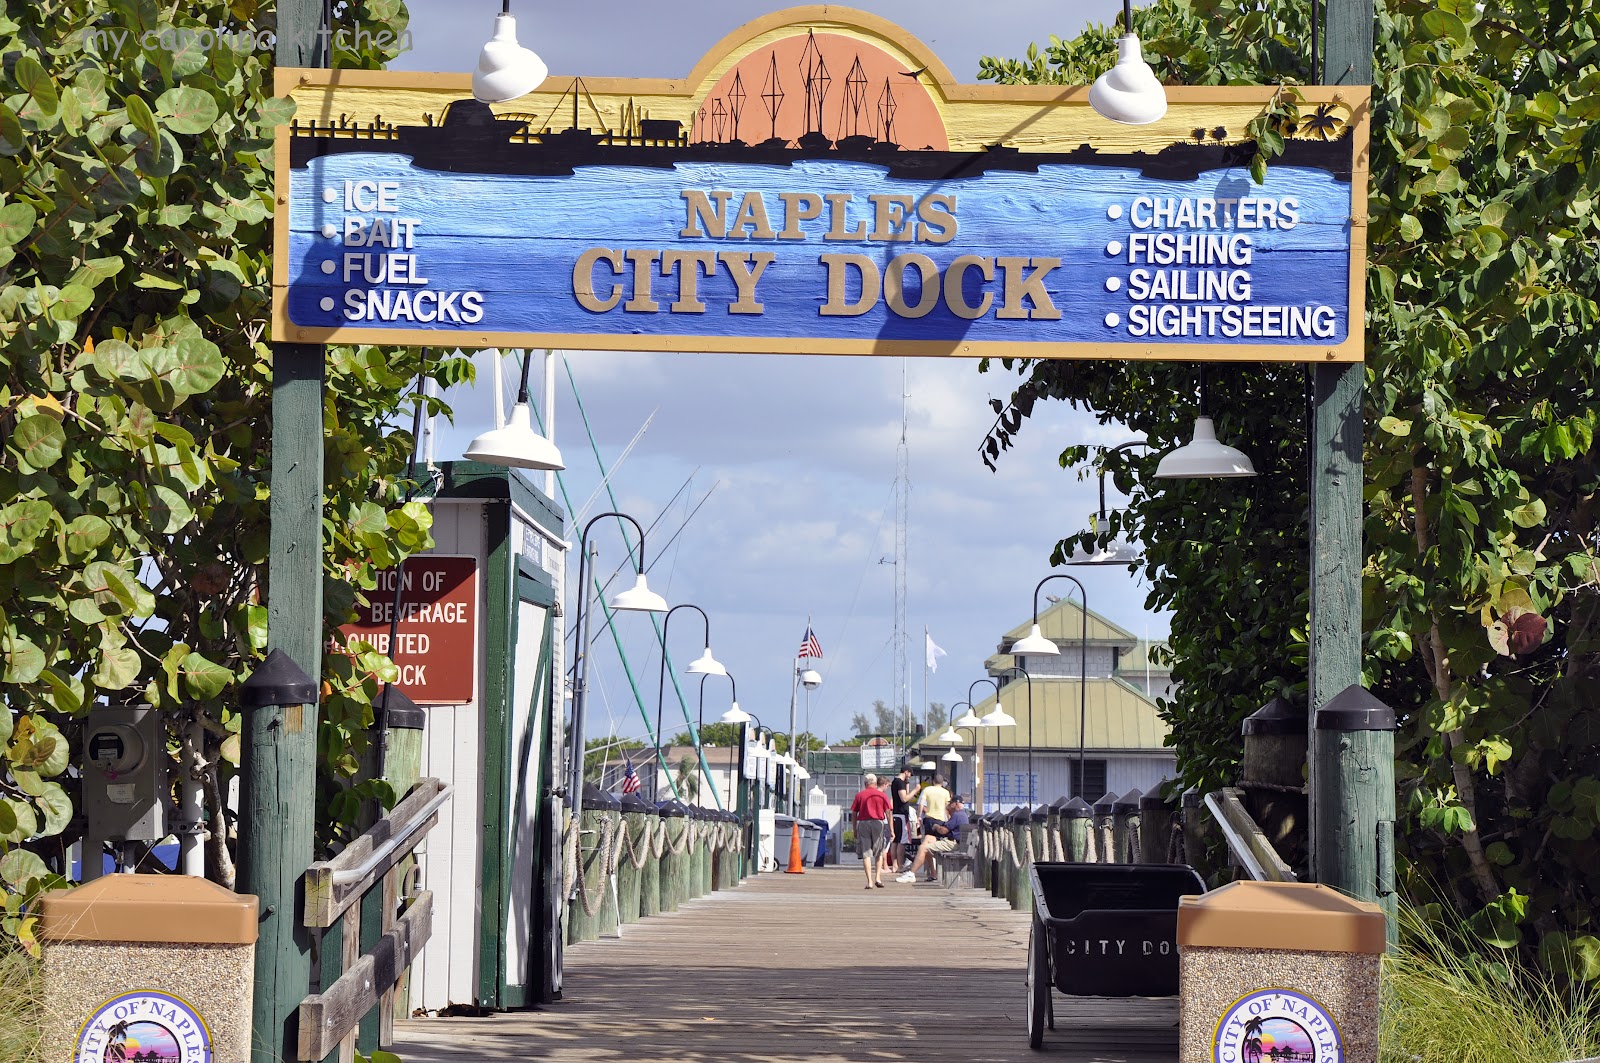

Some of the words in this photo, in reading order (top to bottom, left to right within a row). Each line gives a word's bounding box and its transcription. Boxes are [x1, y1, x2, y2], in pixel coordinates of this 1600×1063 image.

[343, 180, 400, 212] ICE
[680, 190, 959, 244] NAPLES
[1129, 197, 1300, 230] CHARTERS
[343, 216, 422, 249] BAIT
[1128, 233, 1253, 266] FISHING
[343, 252, 429, 285] FUEL
[572, 247, 776, 315] CITY
[818, 252, 1063, 320] DOCK
[1127, 268, 1252, 301] SAILING
[343, 288, 485, 324] SNACKS
[1127, 304, 1336, 338] SIGHTSEEING
[422, 570, 447, 592] OF
[371, 602, 467, 623] BEVERAGE
[323, 632, 430, 655] POIBTED
[377, 664, 427, 686] OCK
[1066, 940, 1126, 955] CITY
[1142, 940, 1180, 955] DO
[114, 1001, 141, 1020] OF
[1222, 1014, 1246, 1063] CITY
[1248, 998, 1273, 1016] OF
[1281, 998, 1334, 1063] NAPLES
